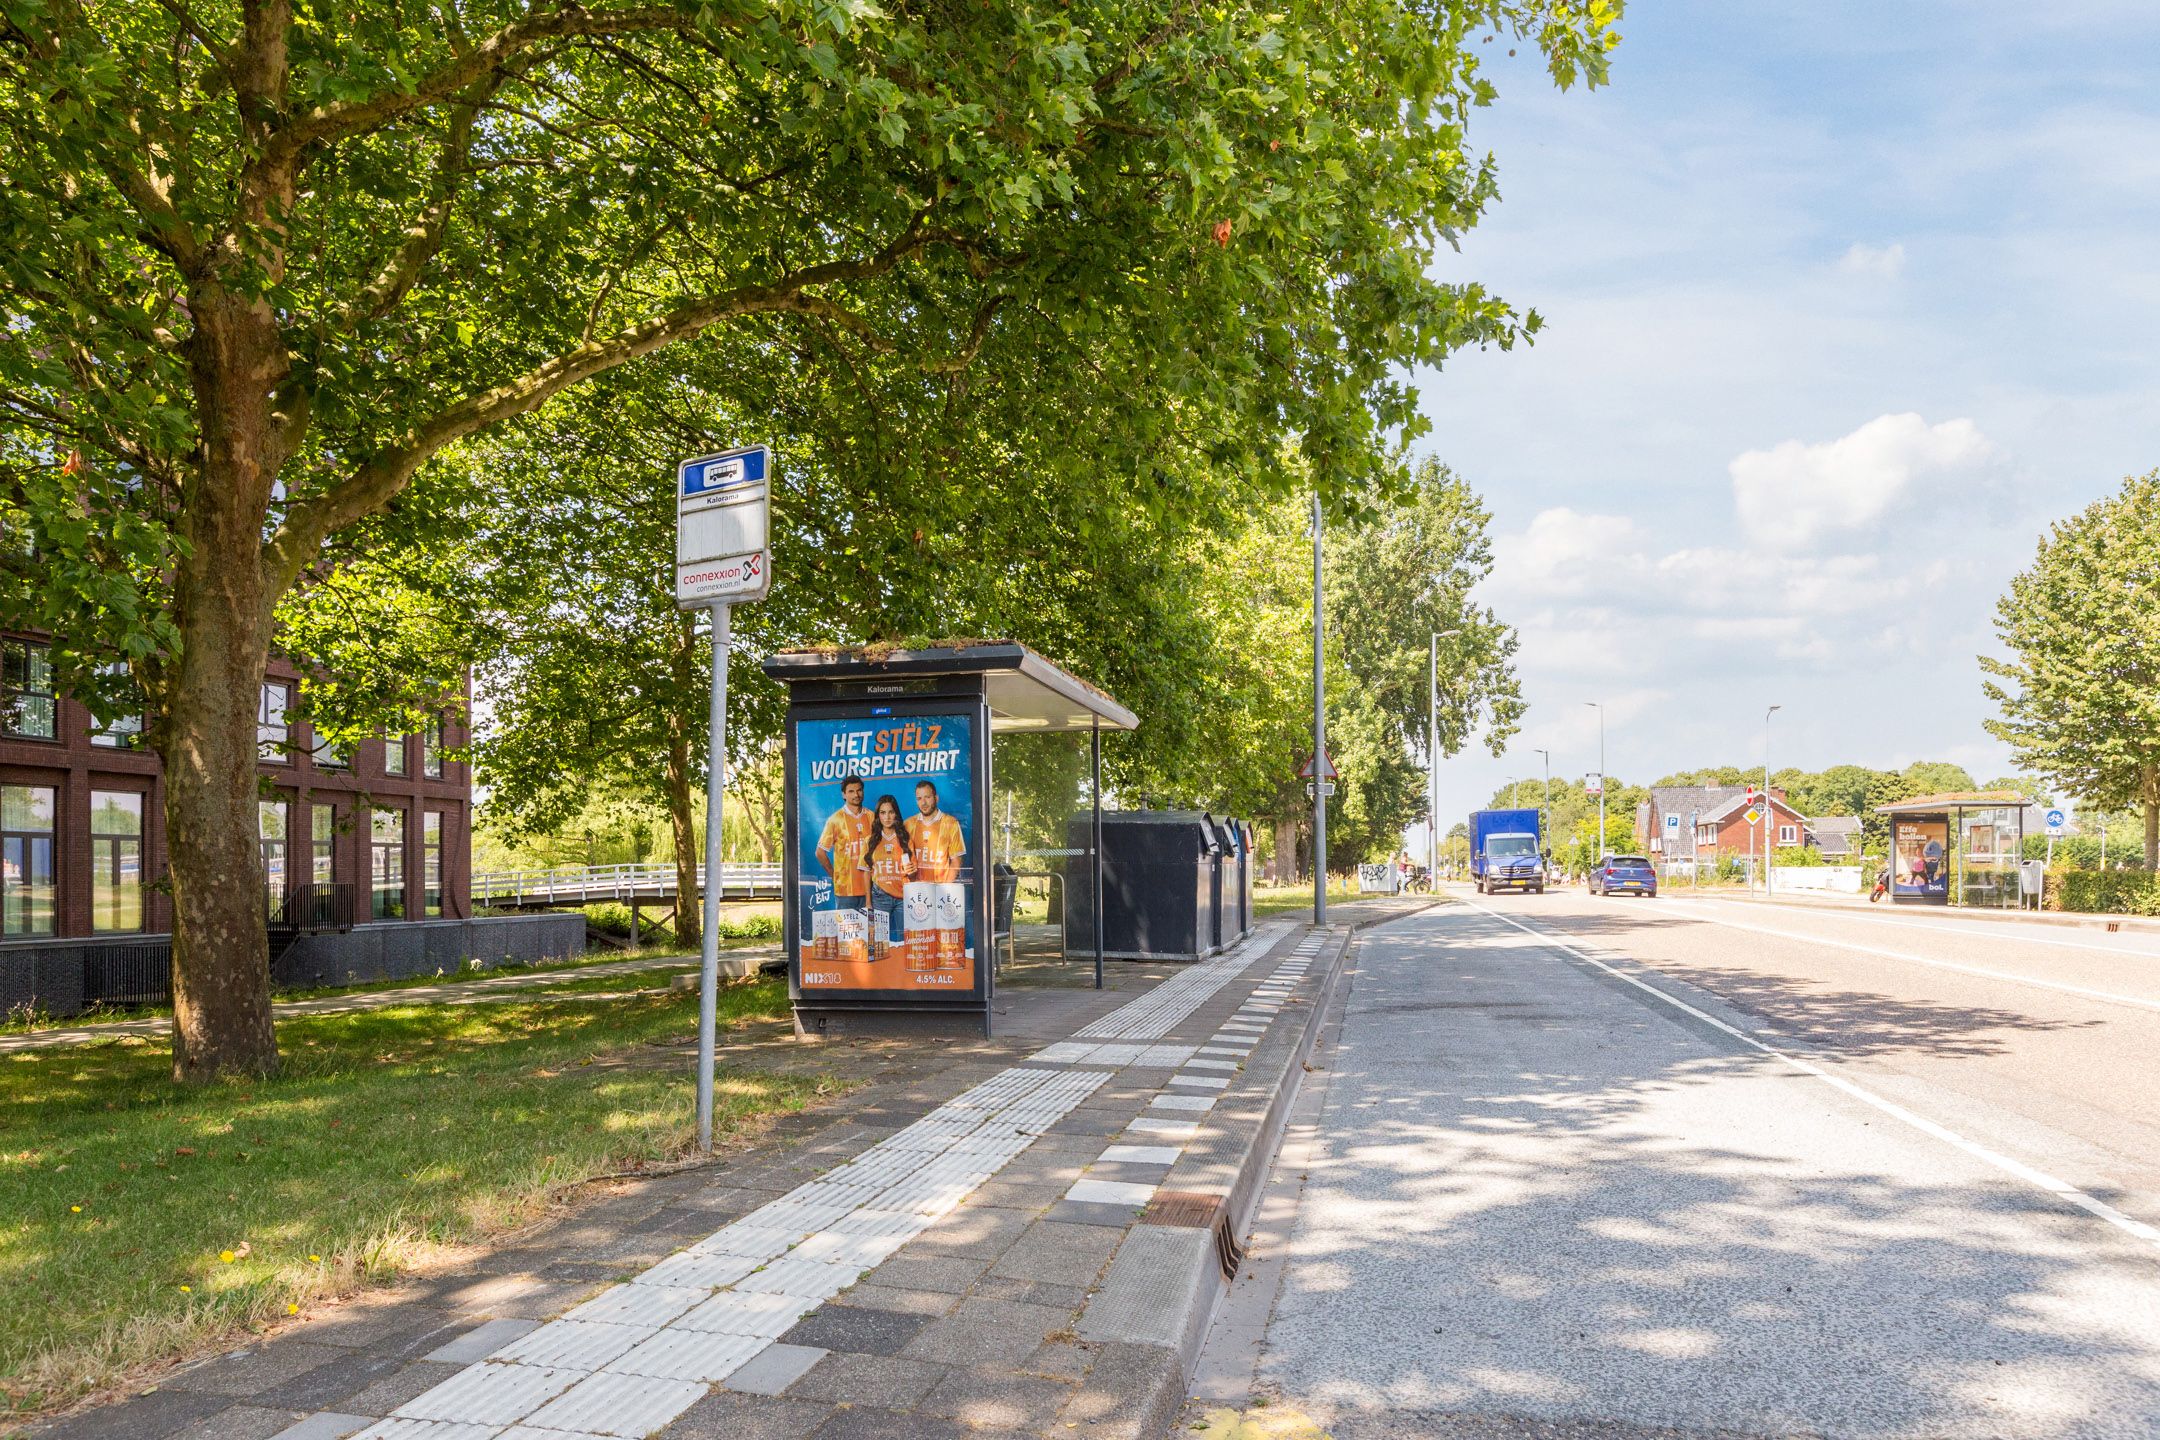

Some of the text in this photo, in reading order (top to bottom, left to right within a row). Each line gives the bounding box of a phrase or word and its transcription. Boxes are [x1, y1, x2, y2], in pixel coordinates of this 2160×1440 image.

[707, 494, 739, 505] Kalorama
[683, 568, 741, 585] connexxion
[696, 579, 741, 593] connexxion.nl
[867, 685, 904, 693] Kalorama
[831, 723, 942, 757] HET STËLZ
[811, 749, 960, 781] VOORSPELSHIRT
[814, 889, 832, 905] BIJ
[916, 974, 956, 984] 4.5% ALC.
